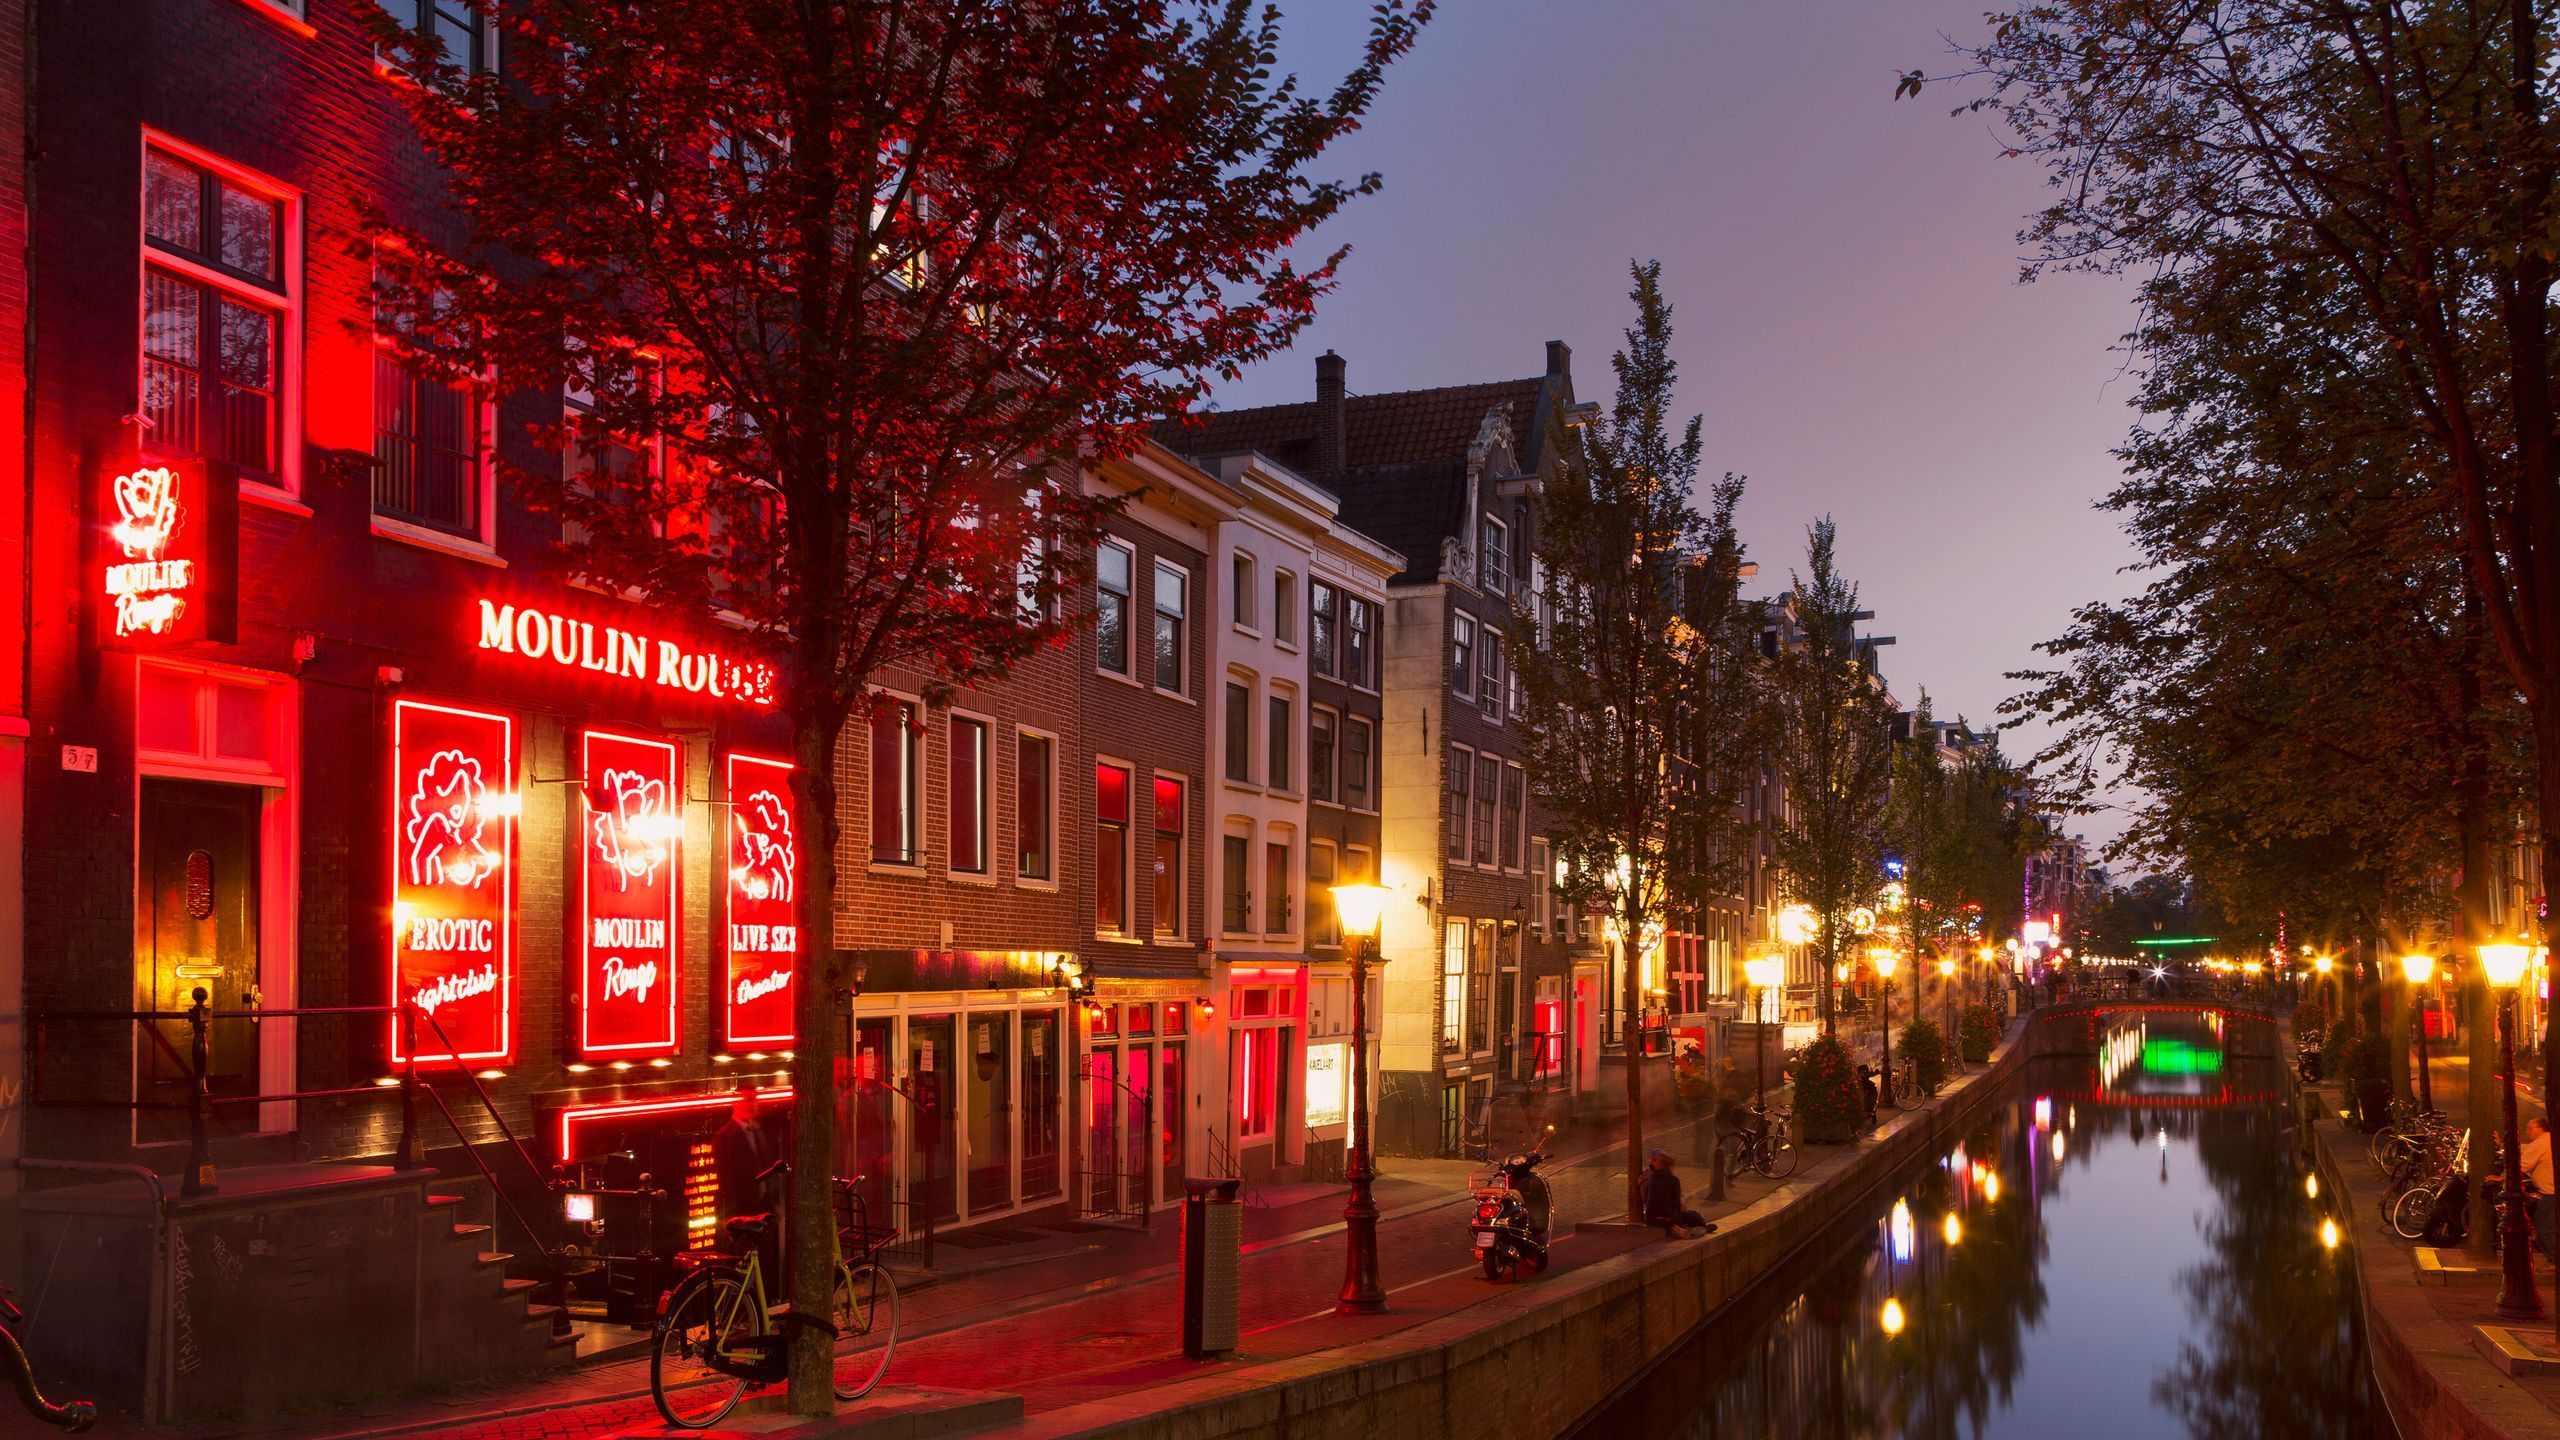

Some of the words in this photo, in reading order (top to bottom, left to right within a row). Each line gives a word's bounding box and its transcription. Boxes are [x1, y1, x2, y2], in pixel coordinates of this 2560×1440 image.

[105, 559, 190, 595] MOULIN
[478, 598, 648, 680] MOULIN
[410, 917, 493, 952] EROTIC
[593, 917, 665, 949] MOULIN
[731, 924, 768, 952] LIVE
[770, 925, 797, 953] SEX
[408, 963, 498, 1015] ightclub
